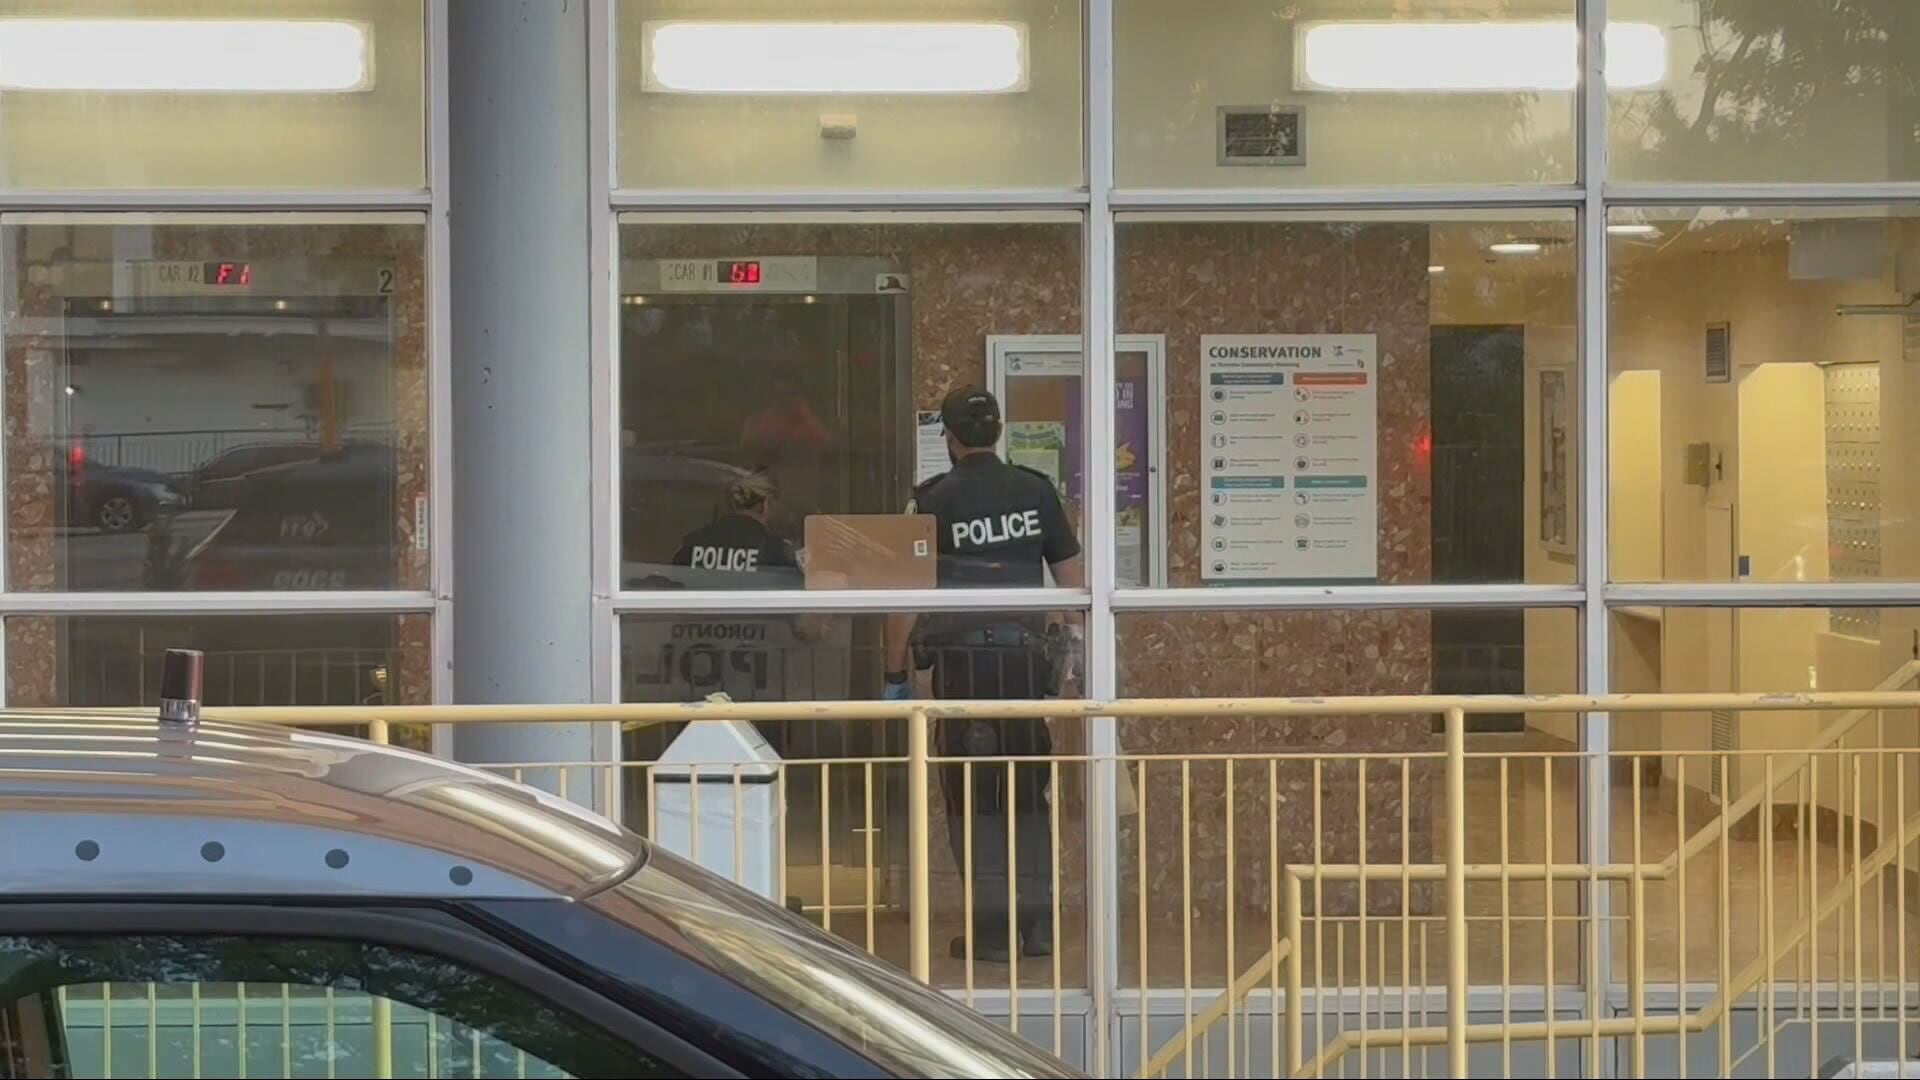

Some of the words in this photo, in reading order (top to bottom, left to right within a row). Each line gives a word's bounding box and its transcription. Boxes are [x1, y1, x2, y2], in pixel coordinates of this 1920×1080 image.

[380, 269, 393, 293] 2
[1208, 346, 1322, 359] CONSERVATION
[951, 509, 1042, 549] POLICE
[691, 545, 760, 572] POLICE
